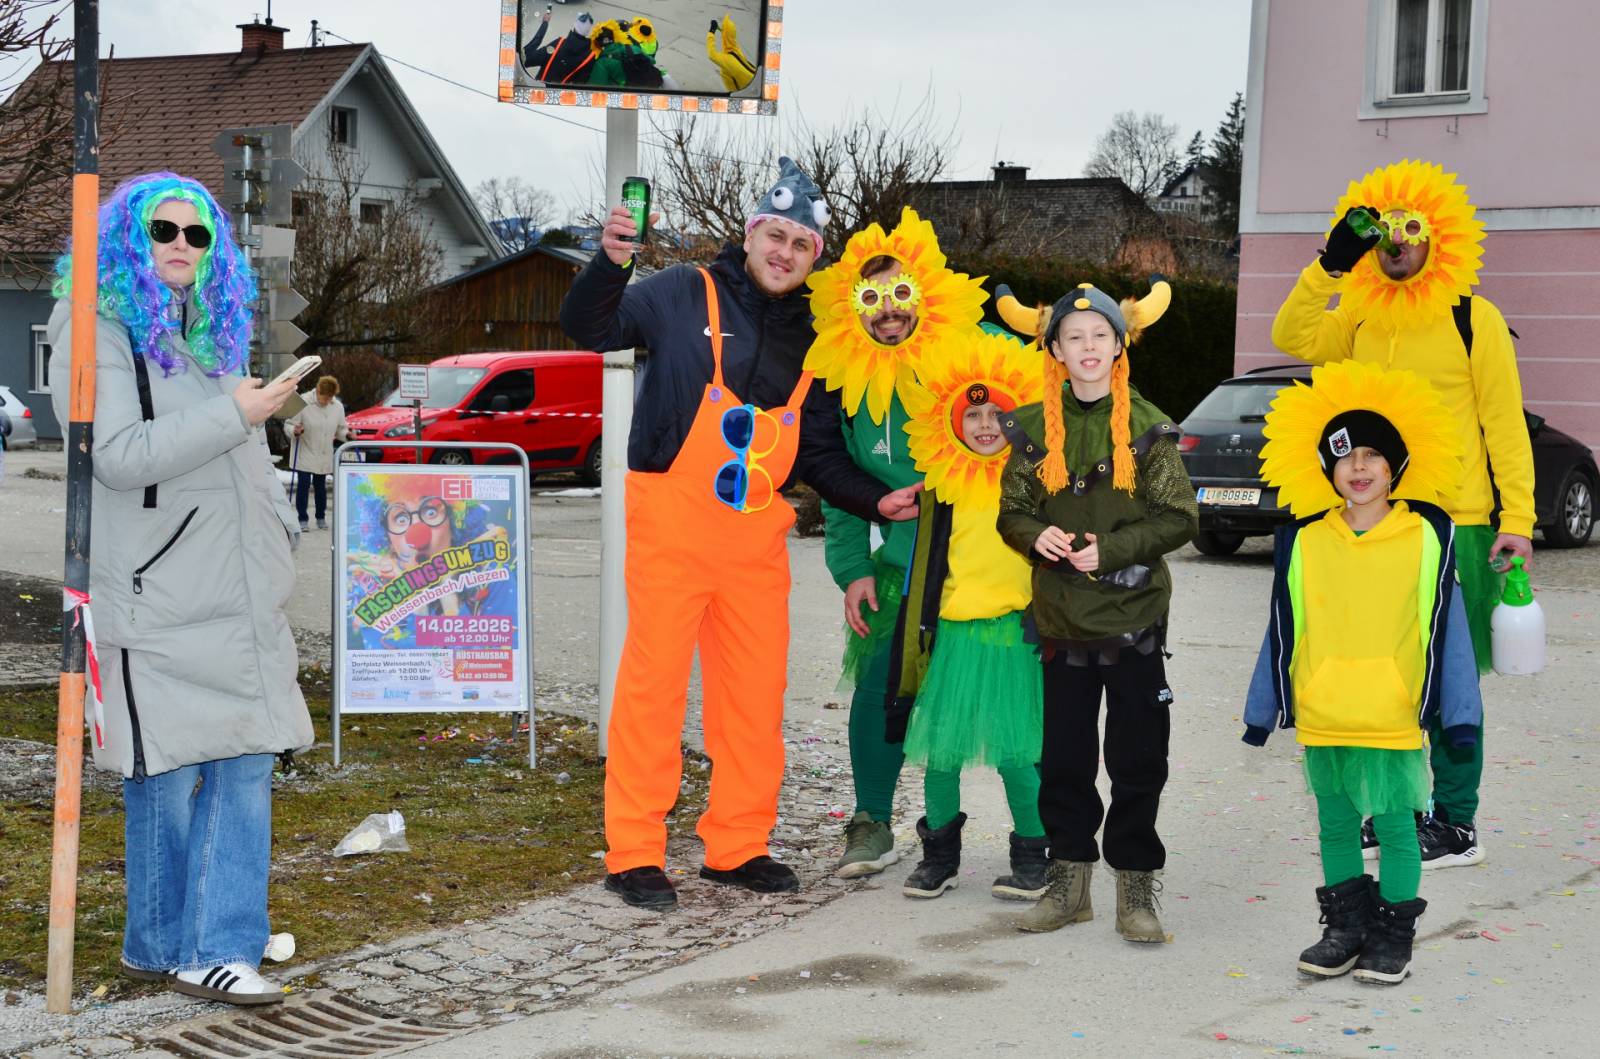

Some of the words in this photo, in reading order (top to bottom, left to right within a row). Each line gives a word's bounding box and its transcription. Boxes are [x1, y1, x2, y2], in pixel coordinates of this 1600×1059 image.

[622, 198, 647, 208] össer
[971, 390, 985, 400] 99
[355, 540, 509, 625] FASCHINGSUMZUG
[376, 570, 507, 632] Weissenbach/Liezen
[418, 619, 510, 633] 14.02.2026
[444, 635, 456, 643] ab
[459, 635, 489, 643] 12.00
[491, 635, 510, 643] Uhr
